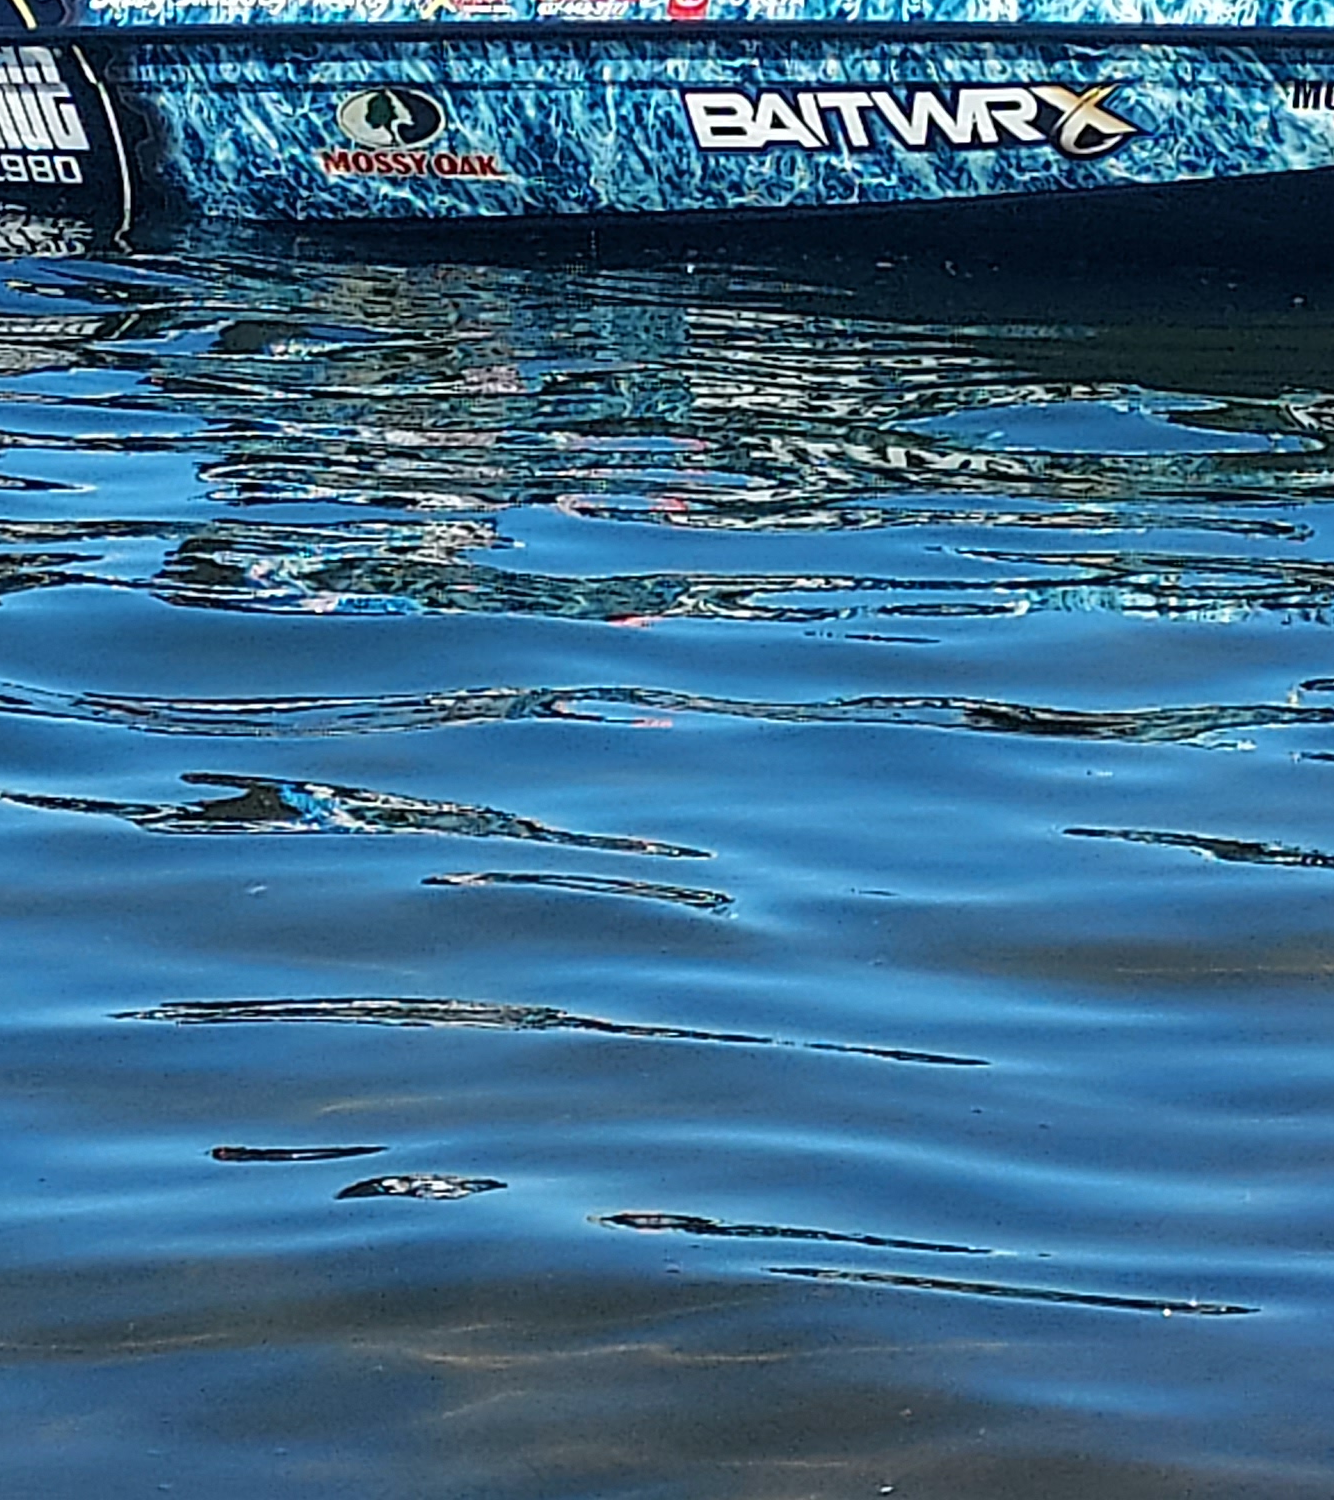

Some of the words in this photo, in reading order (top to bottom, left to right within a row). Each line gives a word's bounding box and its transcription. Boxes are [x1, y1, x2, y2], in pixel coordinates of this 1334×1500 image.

[684, 83, 1139, 155] BAITWRX
[322, 150, 427, 177] MOSSY
[433, 152, 503, 178] OAK
